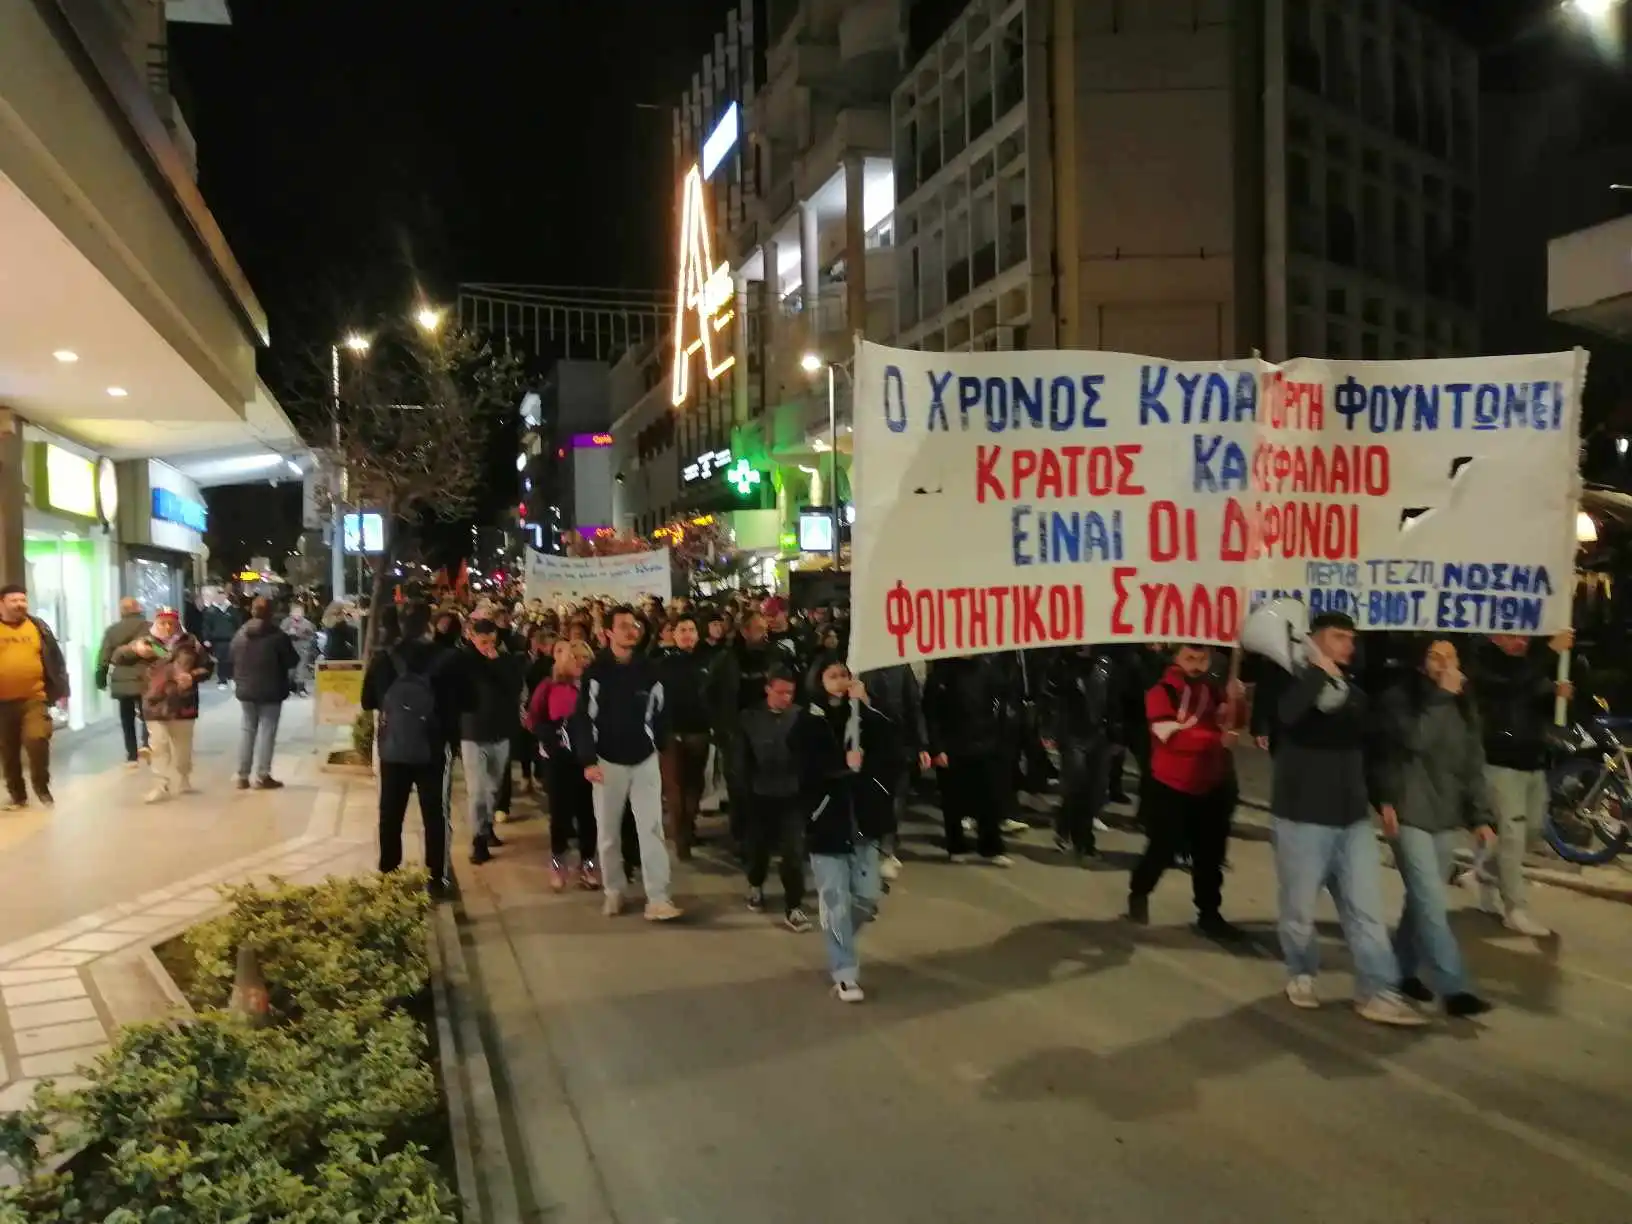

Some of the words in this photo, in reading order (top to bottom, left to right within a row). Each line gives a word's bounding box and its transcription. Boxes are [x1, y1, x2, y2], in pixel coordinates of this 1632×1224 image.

[884, 365, 907, 433] Ο
[928, 370, 1107, 433] ΧΡΟΝΟΣ
[1335, 375, 1564, 433] ΦΟΥΝΤΩΝΕΙ
[976, 444, 1146, 503] ΚΡΑΤΟΣ
[1011, 505, 1124, 565] ΕΙΝΑΙ
[1147, 500, 1198, 562] ΟΙ
[886, 580, 1084, 656] ΦΟΙΤΗΤΙΚΟΙ
